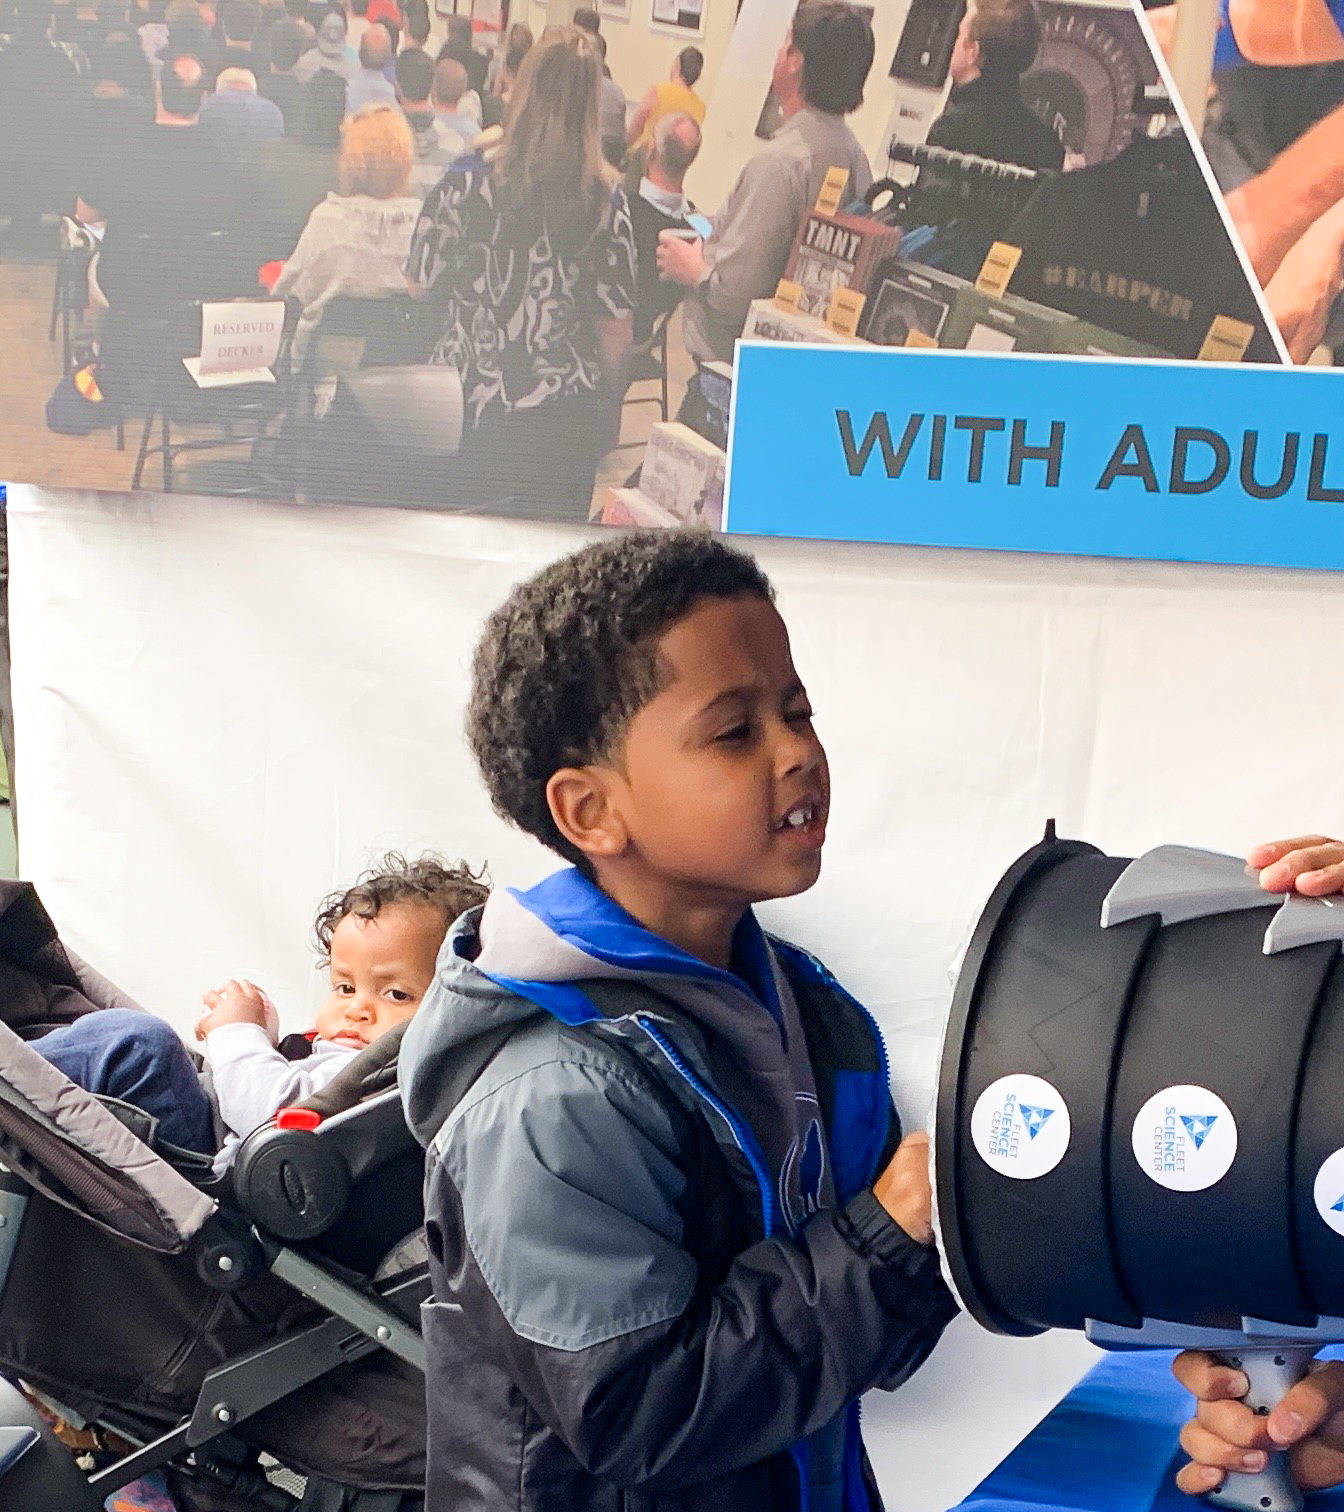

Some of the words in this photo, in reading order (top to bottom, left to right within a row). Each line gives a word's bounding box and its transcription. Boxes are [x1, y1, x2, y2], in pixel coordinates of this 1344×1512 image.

[805, 219, 862, 260] TMNT
[213, 321, 274, 335] RESERVED
[835, 409, 1066, 489] WITH
[988, 1110, 1002, 1155] CENTER
[997, 1093, 1017, 1158] SCIENCE
[1009, 1123, 1021, 1159] FLEET
[1163, 1106, 1176, 1172] SCIENCE
[1153, 1126, 1163, 1172] CENTER
[1176, 1135, 1186, 1172] FLEET
